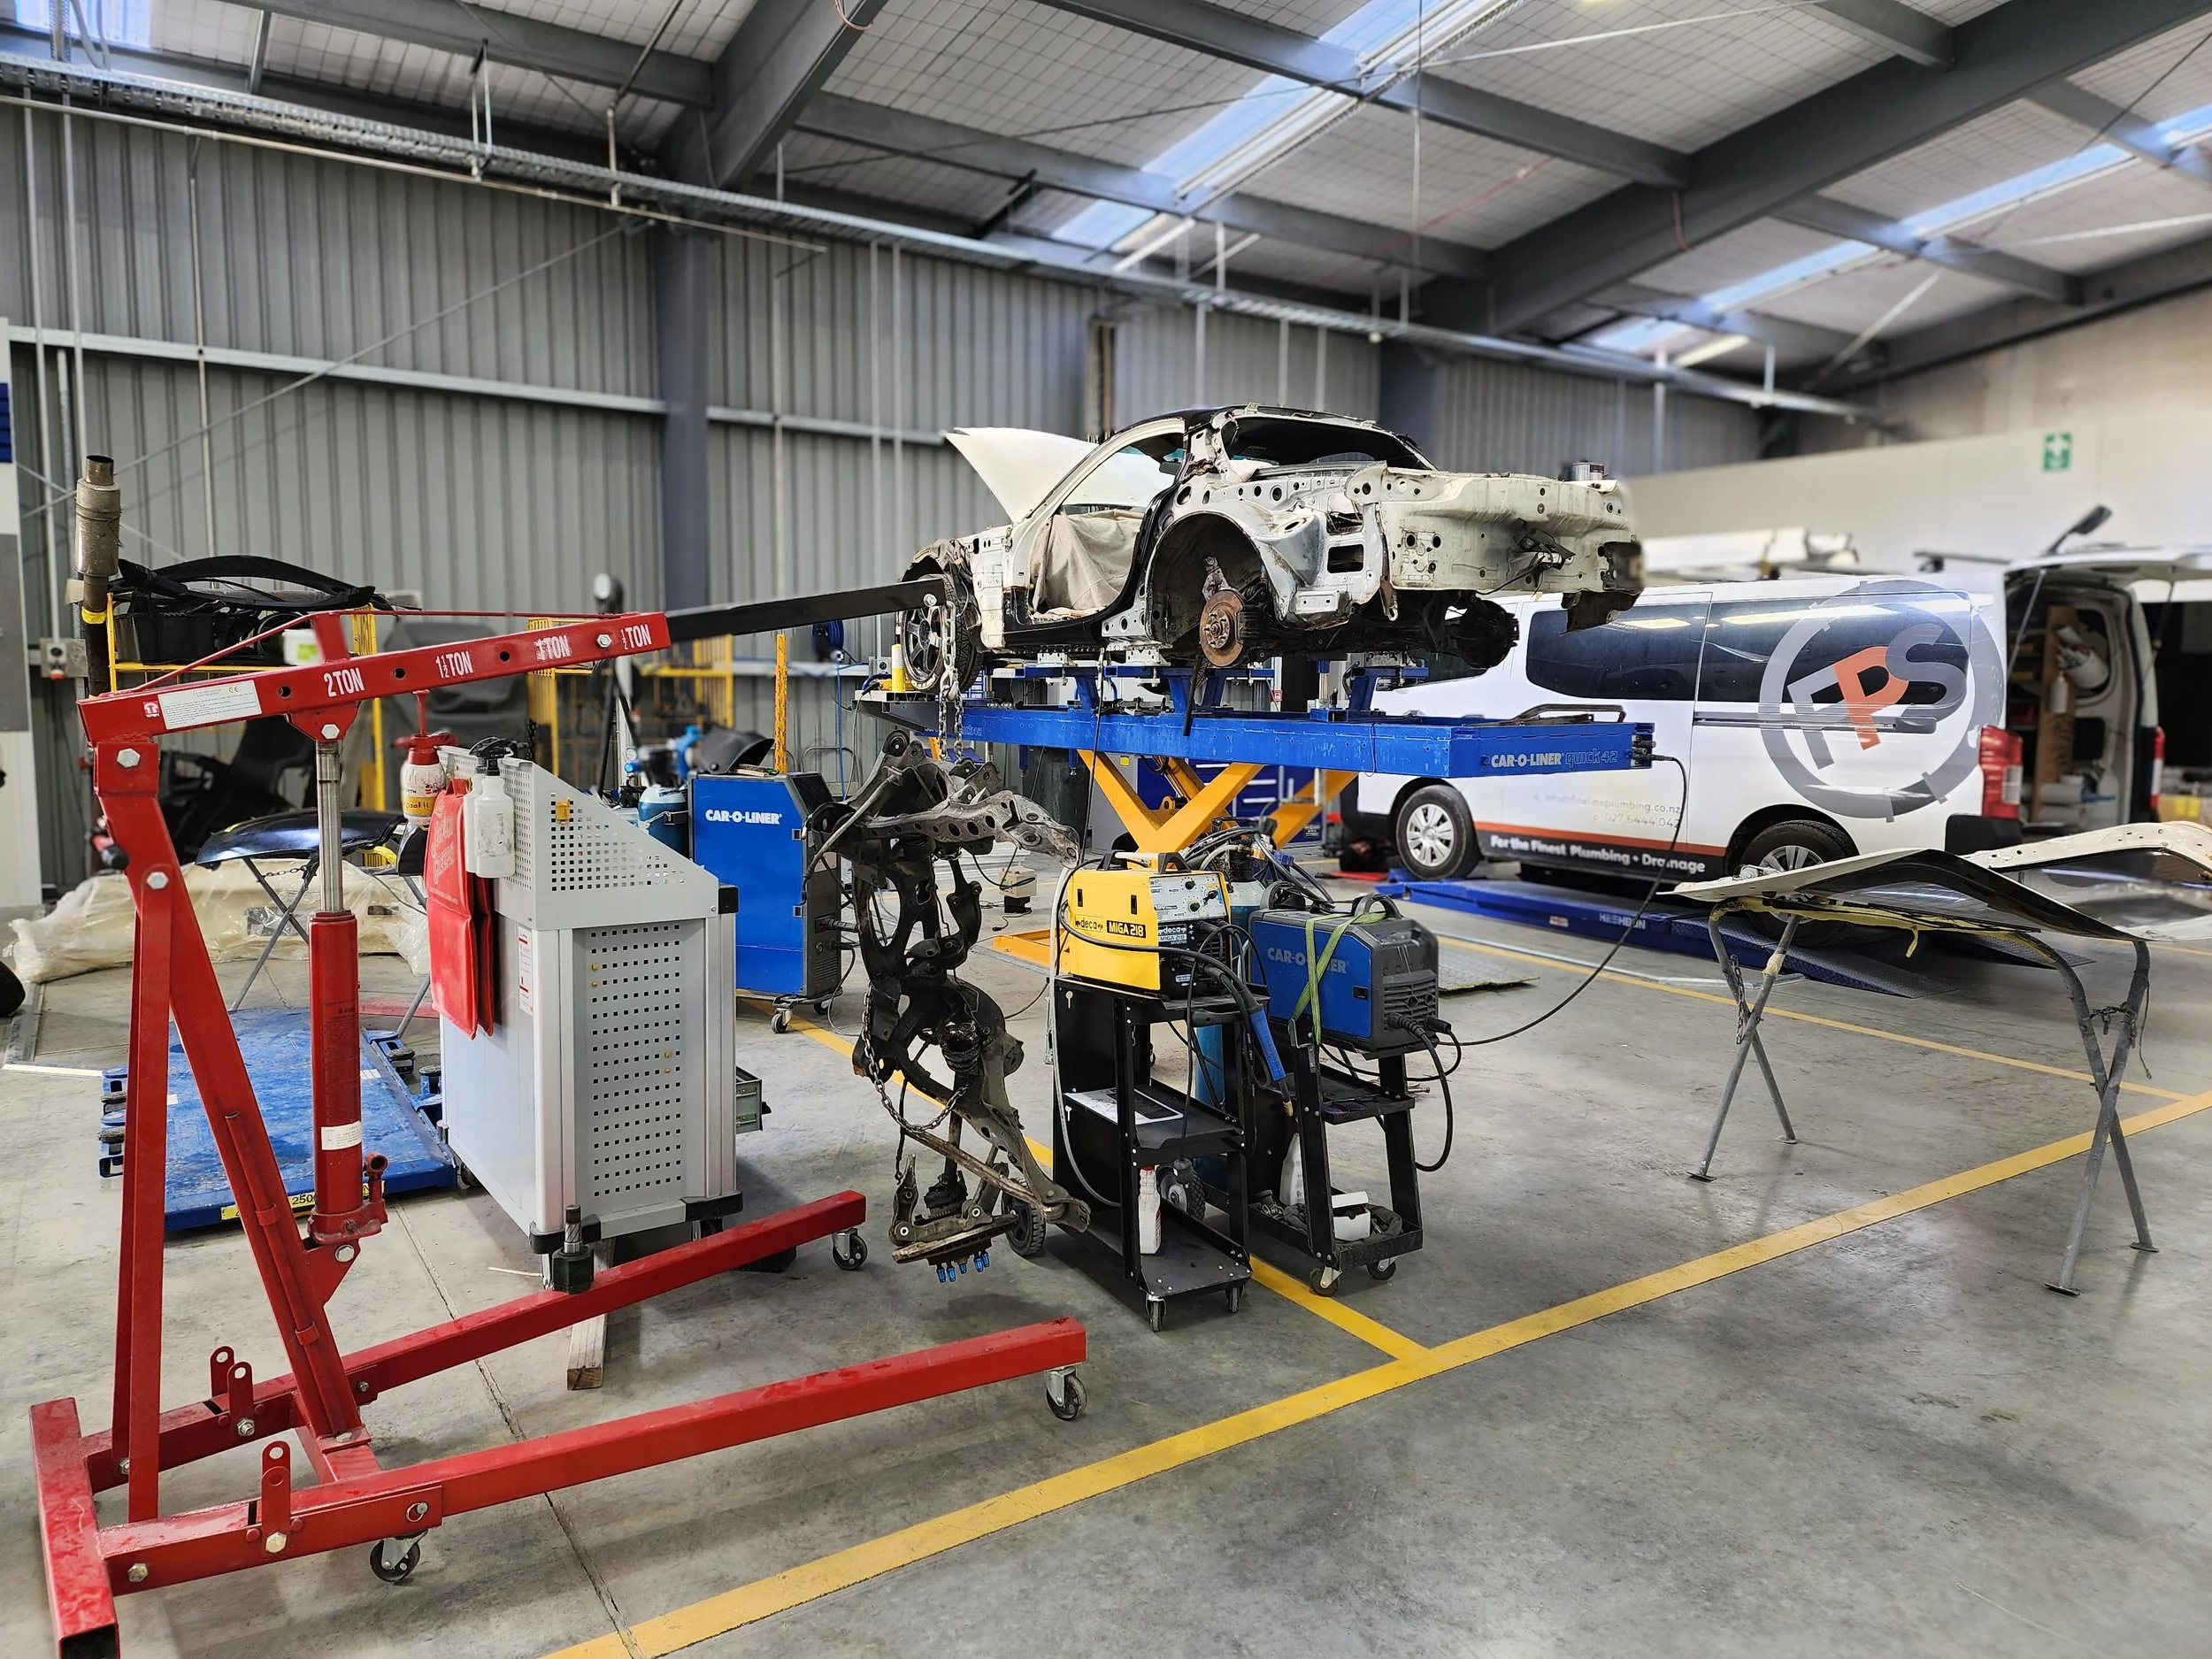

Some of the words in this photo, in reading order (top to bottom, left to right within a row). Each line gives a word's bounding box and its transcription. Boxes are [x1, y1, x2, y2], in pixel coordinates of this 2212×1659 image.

[1491, 753, 1563, 768] CAR-O-LINER
[705, 809, 782, 825] CAR-O-LINER
[1490, 834, 1510, 849] For
[1510, 837, 1531, 851] the
[1531, 838, 1567, 856] Finest
[1570, 845, 1631, 866] Plumbing
[1109, 921, 1129, 935] MIGA
[1130, 925, 1144, 937] 218
[292, 1194, 316, 1205] 250
